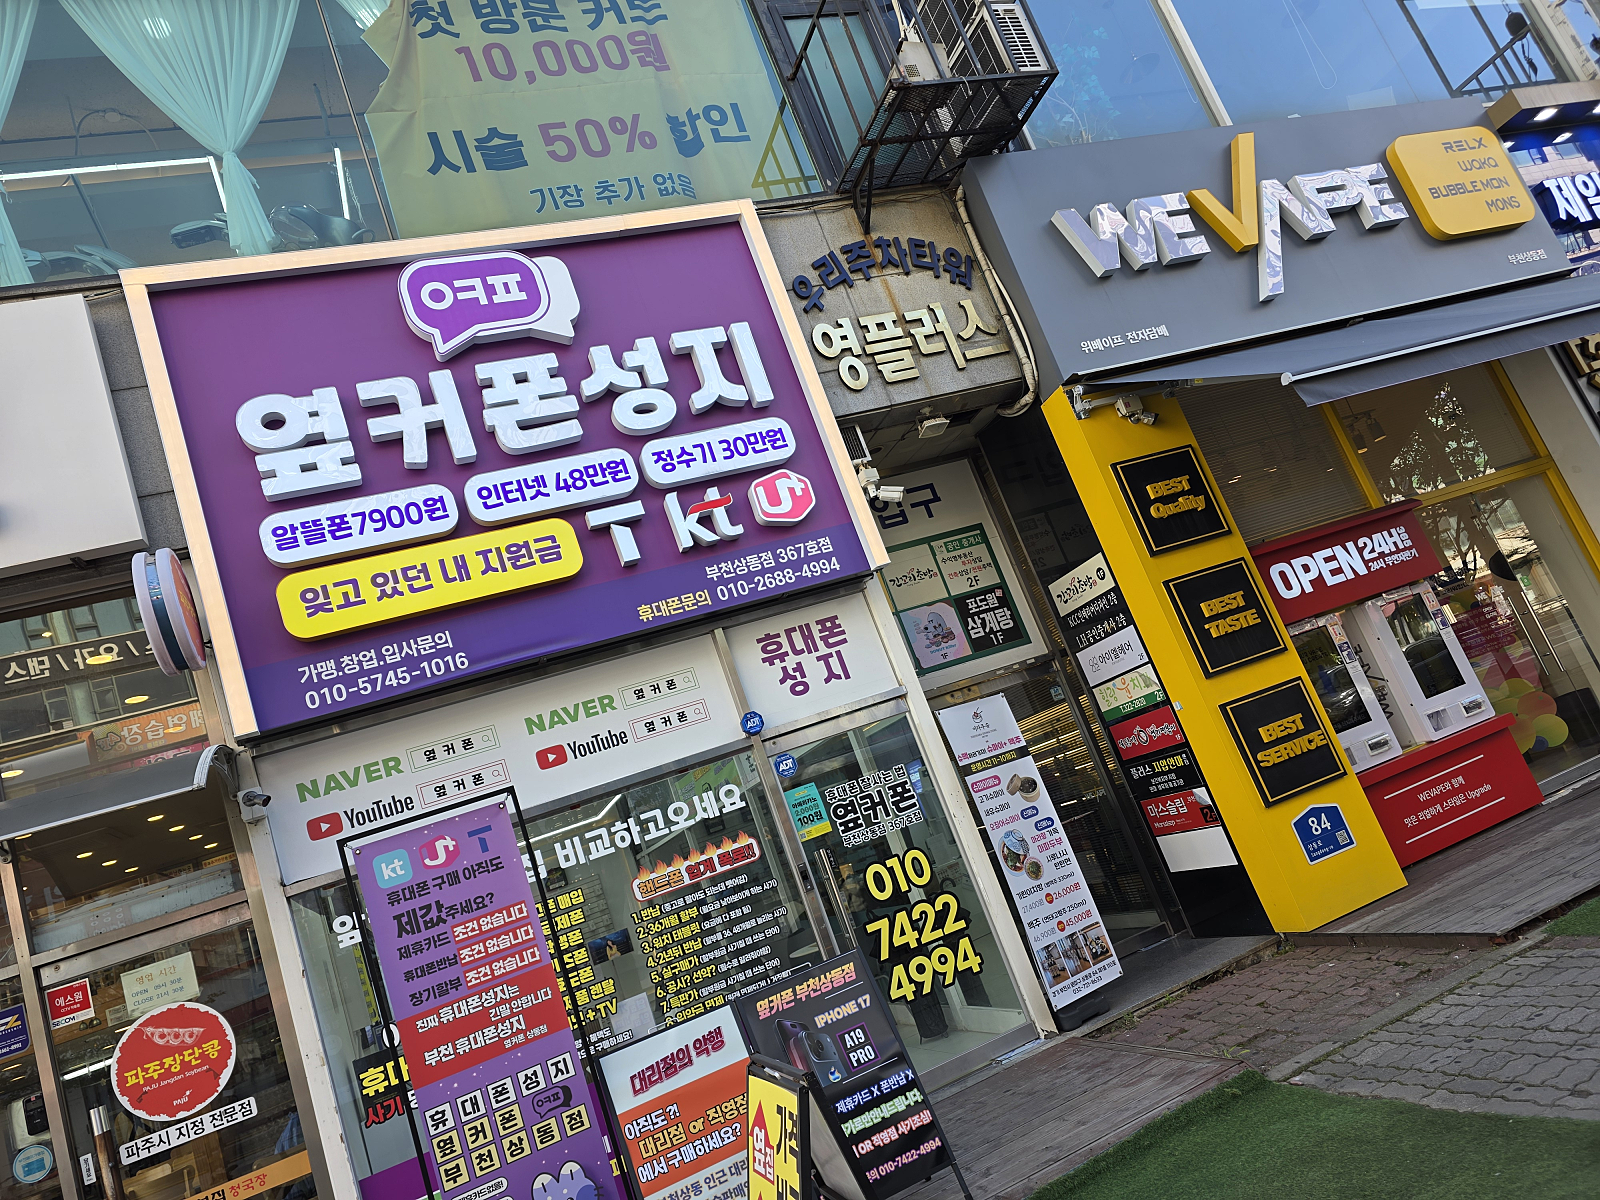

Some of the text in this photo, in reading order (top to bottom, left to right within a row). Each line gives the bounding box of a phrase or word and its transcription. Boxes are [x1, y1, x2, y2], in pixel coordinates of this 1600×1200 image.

[409, 0, 460, 39] 첫
[455, 29, 671, 86] 10,000원
[426, 102, 751, 176] 시술 50% 할인
[1441, 137, 1488, 153] RELX
[529, 171, 697, 214] 기장 추가 없음
[1428, 180, 1482, 199] BUBBLE
[1485, 195, 1521, 213] MONS
[1507, 249, 1548, 265] 부천상동점
[792, 236, 973, 313] 우리주차타워
[812, 299, 1010, 391] 영플러스
[1080, 325, 1170, 356] 위베이프 전자담배
[235, 321, 775, 502] 옆커폰성지
[651, 428, 788, 473] 정수기 30만원
[476, 457, 632, 511] 인터넷 48만원
[1146, 475, 1191, 499] BEST
[664, 486, 744, 554] kt
[870, 483, 942, 529] 입구
[1150, 493, 1206, 519] Quality
[270, 494, 451, 552] 알뜰폰7900원
[706, 537, 833, 581] 부천상동점 367호점
[946, 541, 960, 551] 공인
[298, 534, 563, 619] 잊고 있던 내 지원금
[1269, 541, 1367, 599] OPEN
[1358, 529, 1403, 560] 24H
[1368, 560, 1386, 572] 24시
[637, 556, 841, 623] 휴대폰문의 010-2688-4994
[966, 575, 980, 588] 2F
[965, 593, 999, 614] 포도원
[1067, 591, 1118, 628] KCC인테리어디자인 2층
[1200, 590, 1245, 618] BEST
[966, 607, 1014, 639] 삼계탕
[1075, 612, 1127, 649] LH공인중개사 2층
[1205, 609, 1261, 639] TASTE
[756, 614, 846, 667] 휴대폰
[989, 633, 1004, 645] 1F
[1098, 641, 1145, 665] 아이엘헤어 2F
[298, 631, 454, 685] 가맹.창업.입사문의
[305, 652, 469, 710] 010-5745-1016
[1154, 690, 1165, 702] 2F
[523, 694, 617, 735] NAVER
[747, 719, 760, 729] ADT
[1258, 713, 1305, 744] BEST
[567, 729, 629, 763] YouTube
[1257, 730, 1328, 768] SERVICE
[295, 755, 404, 803] NAVER
[780, 758, 793, 772] ADT
[1130, 765, 1153, 780] 플러스
[1152, 755, 1184, 773] 지압안마
[825, 769, 894, 803] 휴대폰 잘사는
[978, 789, 1005, 804] 고기슈마이
[1417, 780, 1452, 802] WEVAPE와
[1465, 783, 1492, 801] Upgrade
[343, 794, 415, 830] YouTube
[798, 810, 823, 827] 100원
[831, 779, 919, 835] 옆커폰
[887, 811, 924, 832] 367호점
[1147, 797, 1188, 818] 마스슬립
[1203, 808, 1217, 822] 2F
[554, 783, 746, 869] 비교하고오세요
[1308, 813, 1332, 835] 84
[1308, 840, 1323, 851] 상동로
[381, 858, 405, 880] kt
[386, 880, 431, 907] 휴대폰
[431, 870, 460, 891] 구매
[462, 855, 505, 881] 아직도
[637, 868, 685, 899] 핸드폰
[865, 849, 931, 901] 010
[557, 889, 584, 909] 매입
[1015, 871, 1075, 901] 기린이치방 330ml)
[1021, 881, 1082, 914] 27,400원 26,000원
[640, 905, 661, 921] 반납
[647, 915, 680, 937] 36개월
[865, 893, 967, 961] 7422
[1026, 898, 1087, 930] 백주 250ml)
[1033, 908, 1093, 943] 46,900원 45,000원
[396, 931, 452, 961] 제휴카드
[479, 902, 529, 931] 없습니다
[459, 942, 486, 964] 조건
[661, 955, 700, 980] 실구매가
[135, 965, 177, 986] 영업 시간
[889, 936, 982, 1001] 4994
[54, 991, 83, 1007] 에스원
[131, 988, 149, 998] OPEN
[133, 995, 155, 1007] CLOSE
[408, 976, 463, 1008] 장기할부
[438, 983, 520, 1023] 휴대폰성지는
[511, 986, 553, 1012] 안합니다
[589, 978, 616, 1000] 렌탈
[597, 998, 618, 1019] TV
[756, 990, 795, 1021] 옆커폰
[814, 1002, 858, 1029] IPHONE
[52, 1015, 76, 1028] SECOM
[455, 1014, 527, 1055] 휴대폰성지
[503, 1034, 526, 1050] 옆커폰
[844, 1028, 866, 1049] A19
[124, 1039, 221, 1087] 파주장단콩
[630, 1025, 727, 1097] 대리점의 악행
[849, 1045, 876, 1067] PRO
[142, 1082, 159, 1092] PAJU
[172, 1096, 189, 1106] PAJU
[835, 1088, 873, 1114] 제휴카드
[124, 1100, 254, 1160] 파주시 지정 전문점
[638, 1123, 687, 1159] 대리점
[872, 1126, 899, 1149] 직영점
[668, 1122, 741, 1169] 구매하세요?
[879, 1137, 942, 1176] 010-7422-4994
[228, 1173, 267, 1198] 청국장
[704, 1169, 728, 1190] 인근
